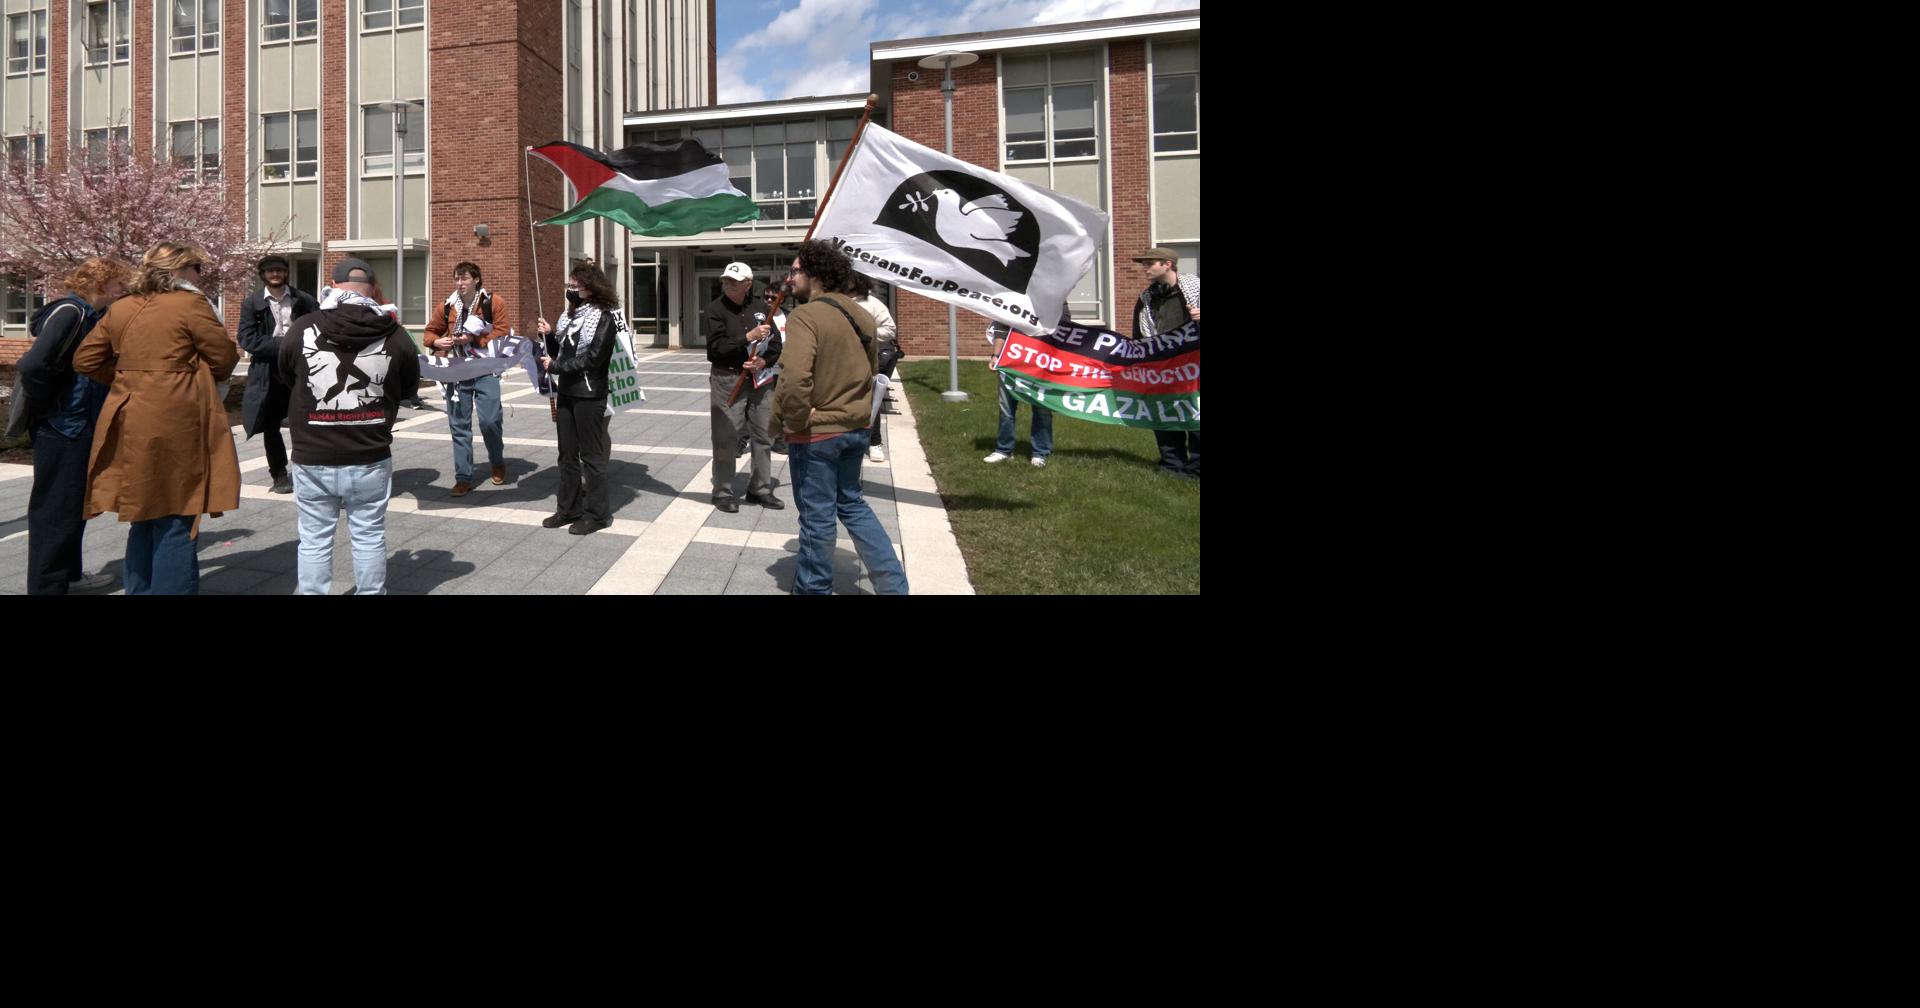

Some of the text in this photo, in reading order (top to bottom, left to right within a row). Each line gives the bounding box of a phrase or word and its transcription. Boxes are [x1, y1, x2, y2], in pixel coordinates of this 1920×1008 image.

[832, 236, 1039, 326] VeteransForPeace.org
[1051, 320, 1199, 359] EE PALESTINE
[1006, 343, 1200, 385] STOP THE GENOCID
[608, 375, 636, 391] tho
[611, 389, 640, 407] hun
[1062, 390, 1152, 421] GAZA
[1156, 397, 1200, 422] LIV
